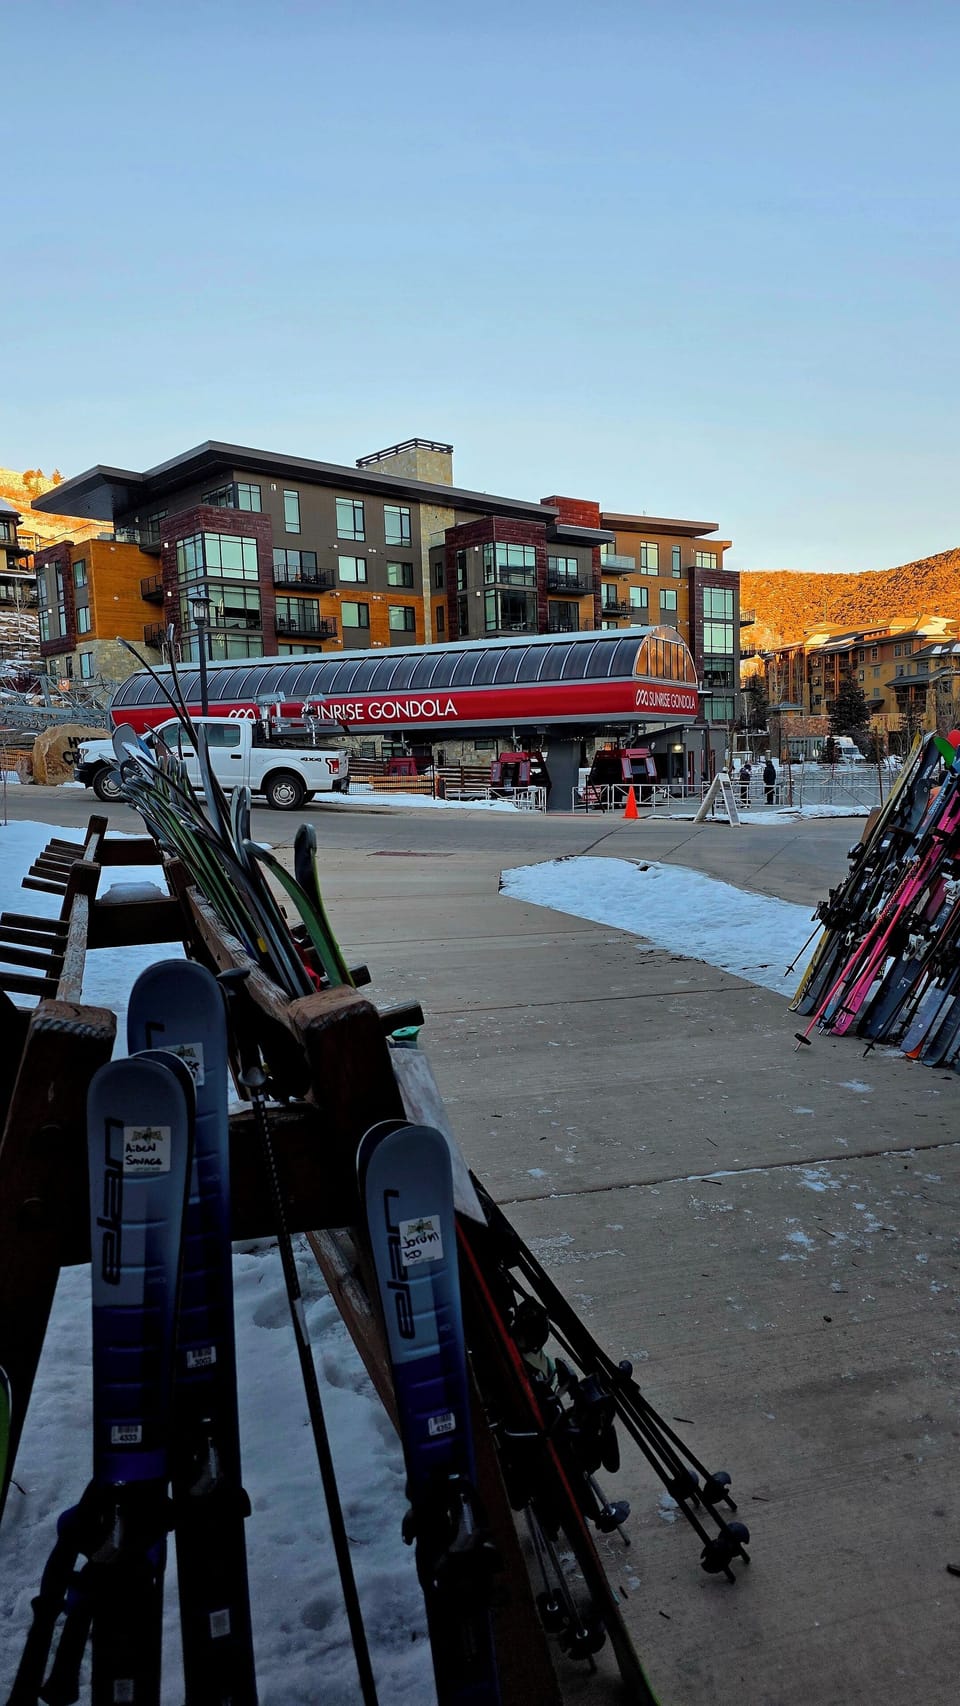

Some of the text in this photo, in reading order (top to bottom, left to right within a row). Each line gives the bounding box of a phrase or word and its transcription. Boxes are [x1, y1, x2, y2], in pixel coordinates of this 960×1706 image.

[368, 699, 458, 720] GONDOLA
[649, 691, 696, 710] SUNRISE GONDOLA
